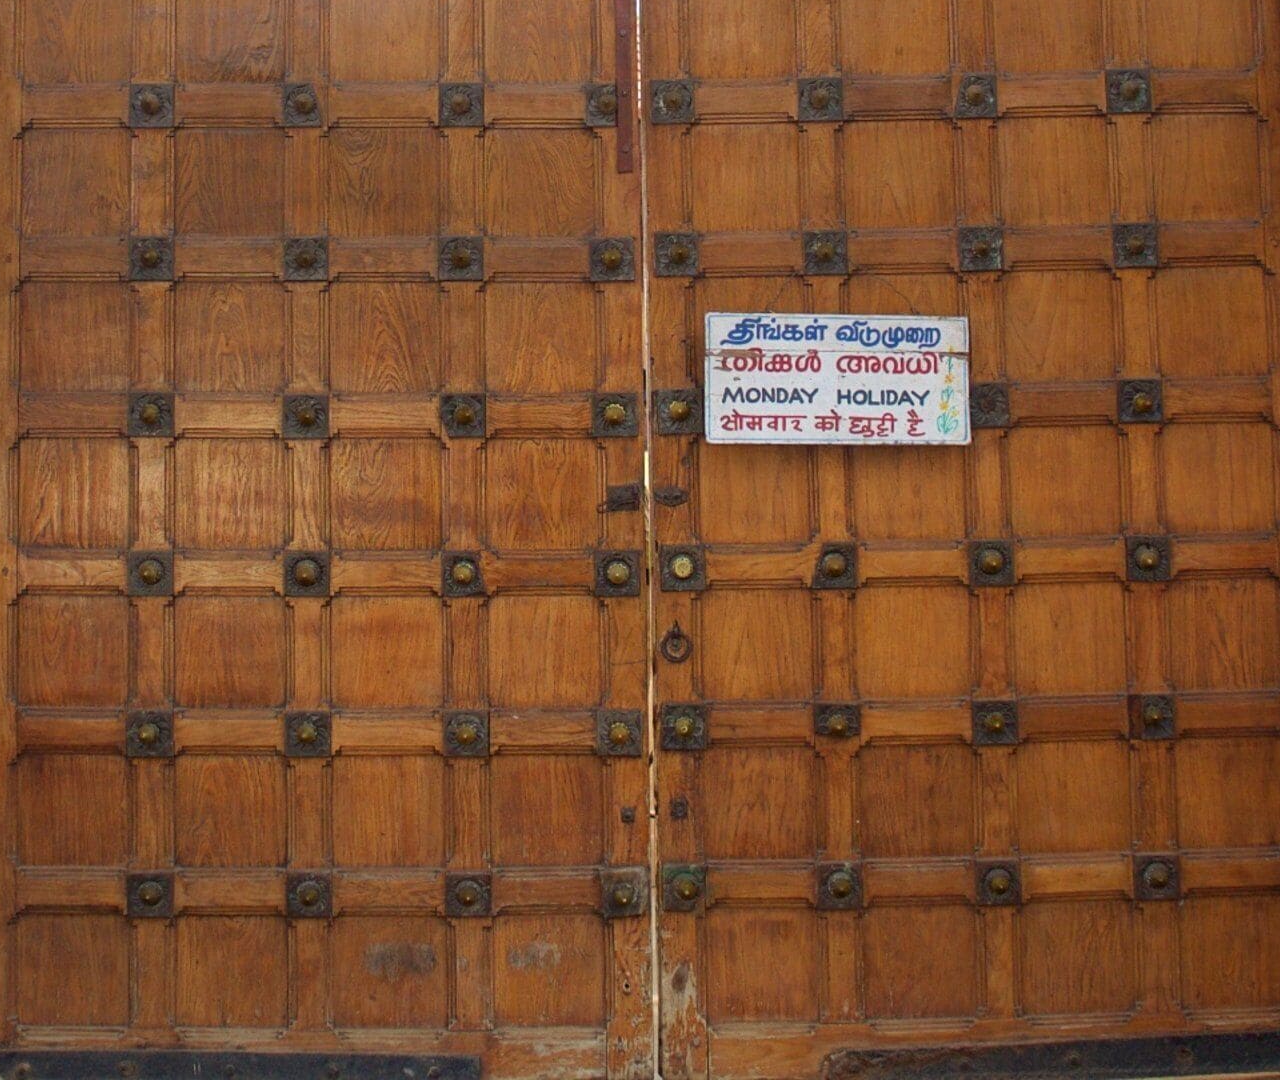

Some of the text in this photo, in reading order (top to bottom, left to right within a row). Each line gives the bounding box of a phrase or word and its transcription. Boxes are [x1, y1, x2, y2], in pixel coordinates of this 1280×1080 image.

[720, 316, 941, 349] திங்கள் விடுமுறை
[836, 351, 939, 375] അവധി
[721, 387, 930, 407] MONDAY HOLIDAY
[720, 409, 807, 432] सोमवार
[814, 409, 842, 432] को
[906, 409, 926, 437] है
